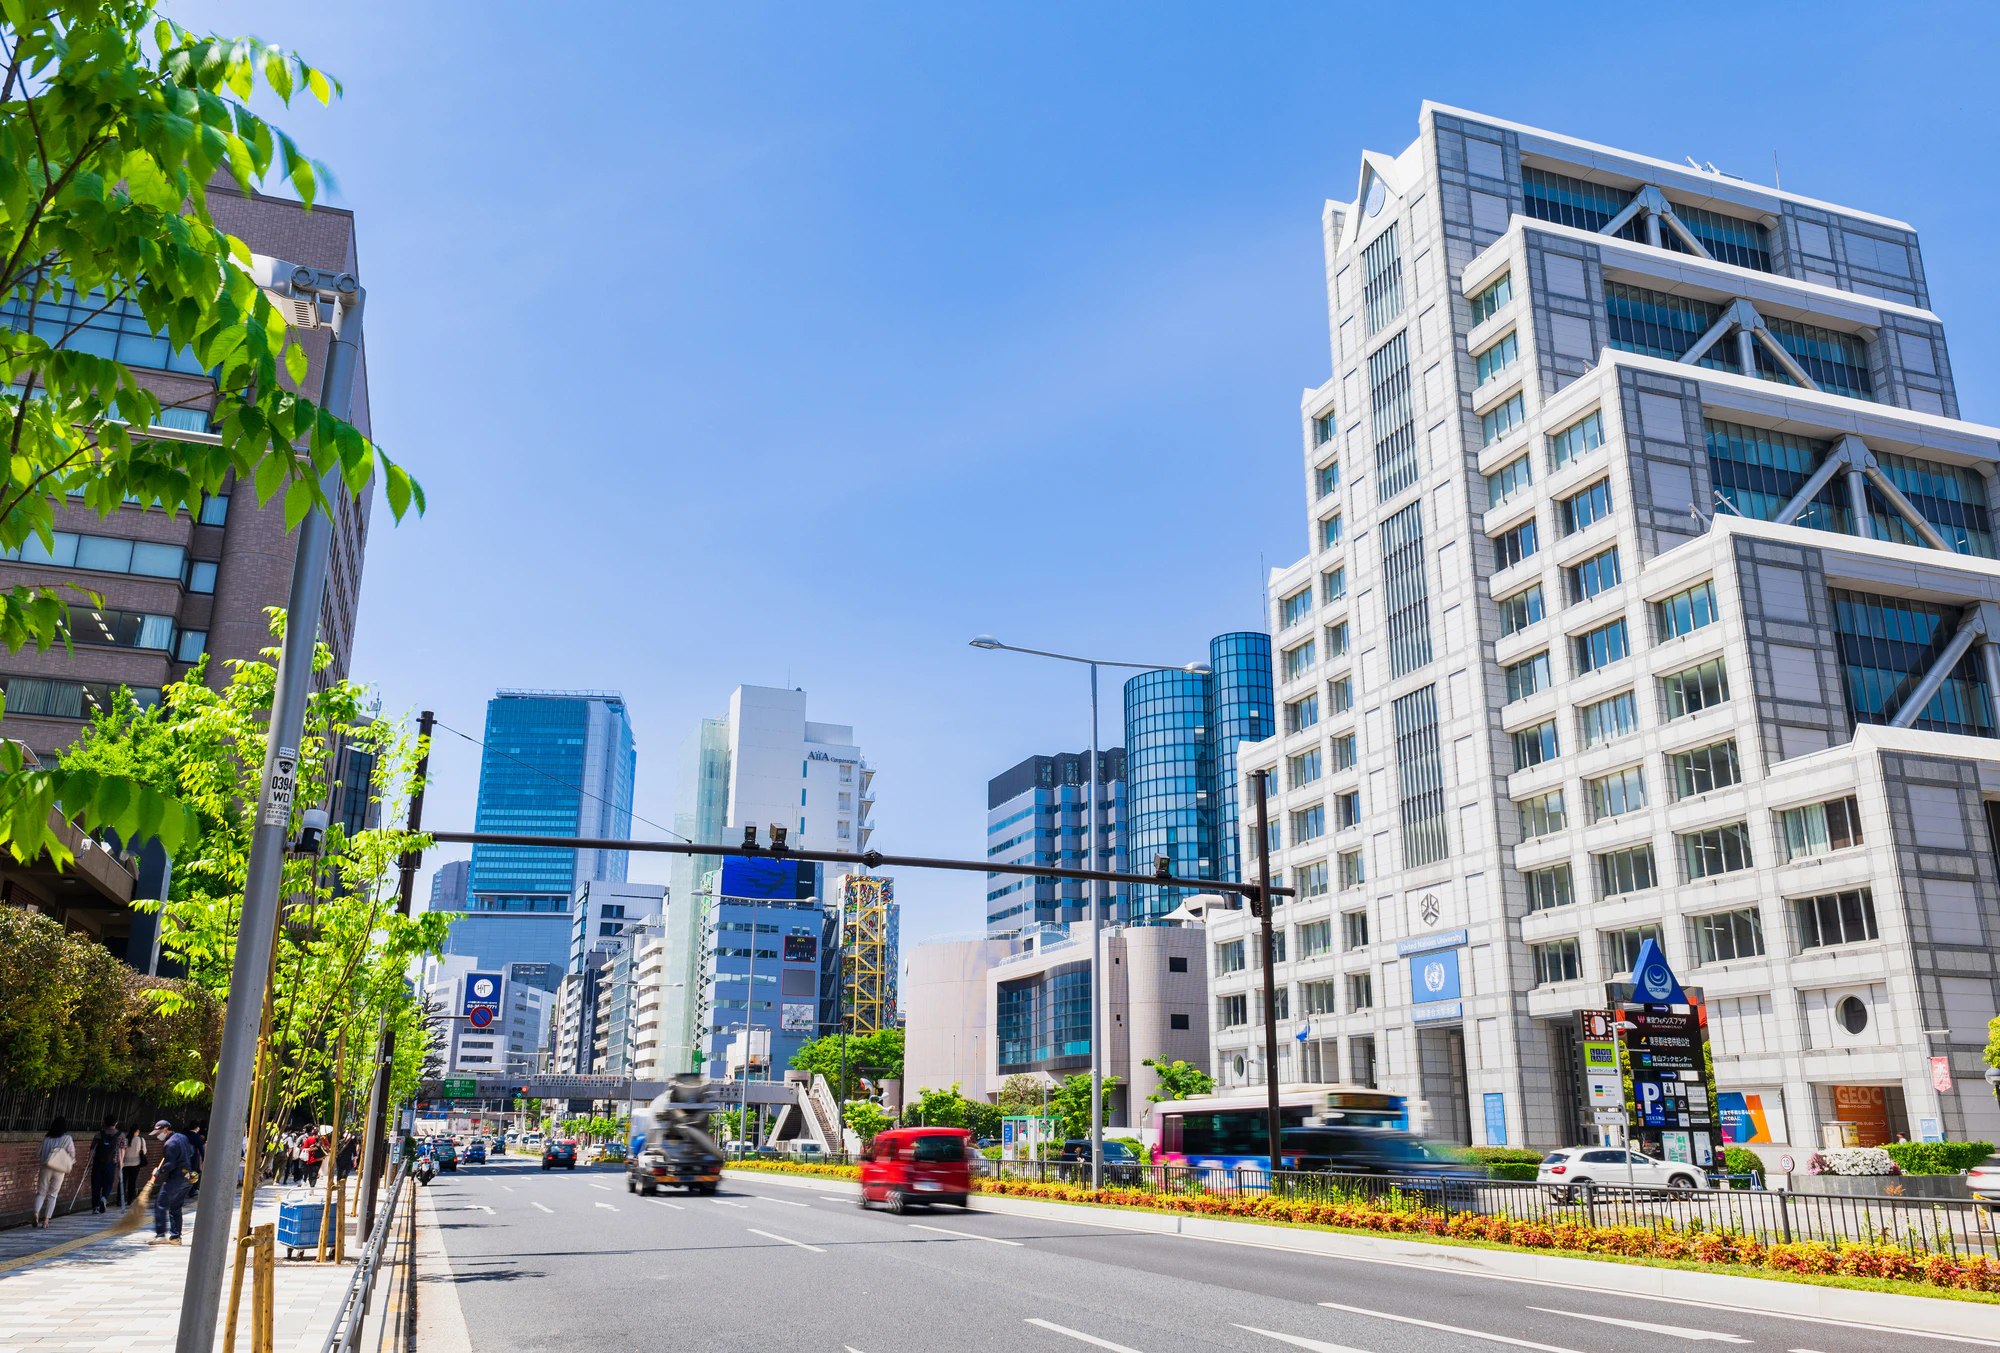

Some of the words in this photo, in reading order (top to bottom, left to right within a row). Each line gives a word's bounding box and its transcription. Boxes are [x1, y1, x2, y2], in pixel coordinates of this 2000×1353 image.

[273, 791, 290, 803] WD
[1401, 943, 1416, 951] United
[1418, 939, 1436, 948] Nations
[1437, 934, 1462, 945] University
[1836, 1086, 1883, 1105] GEOC
